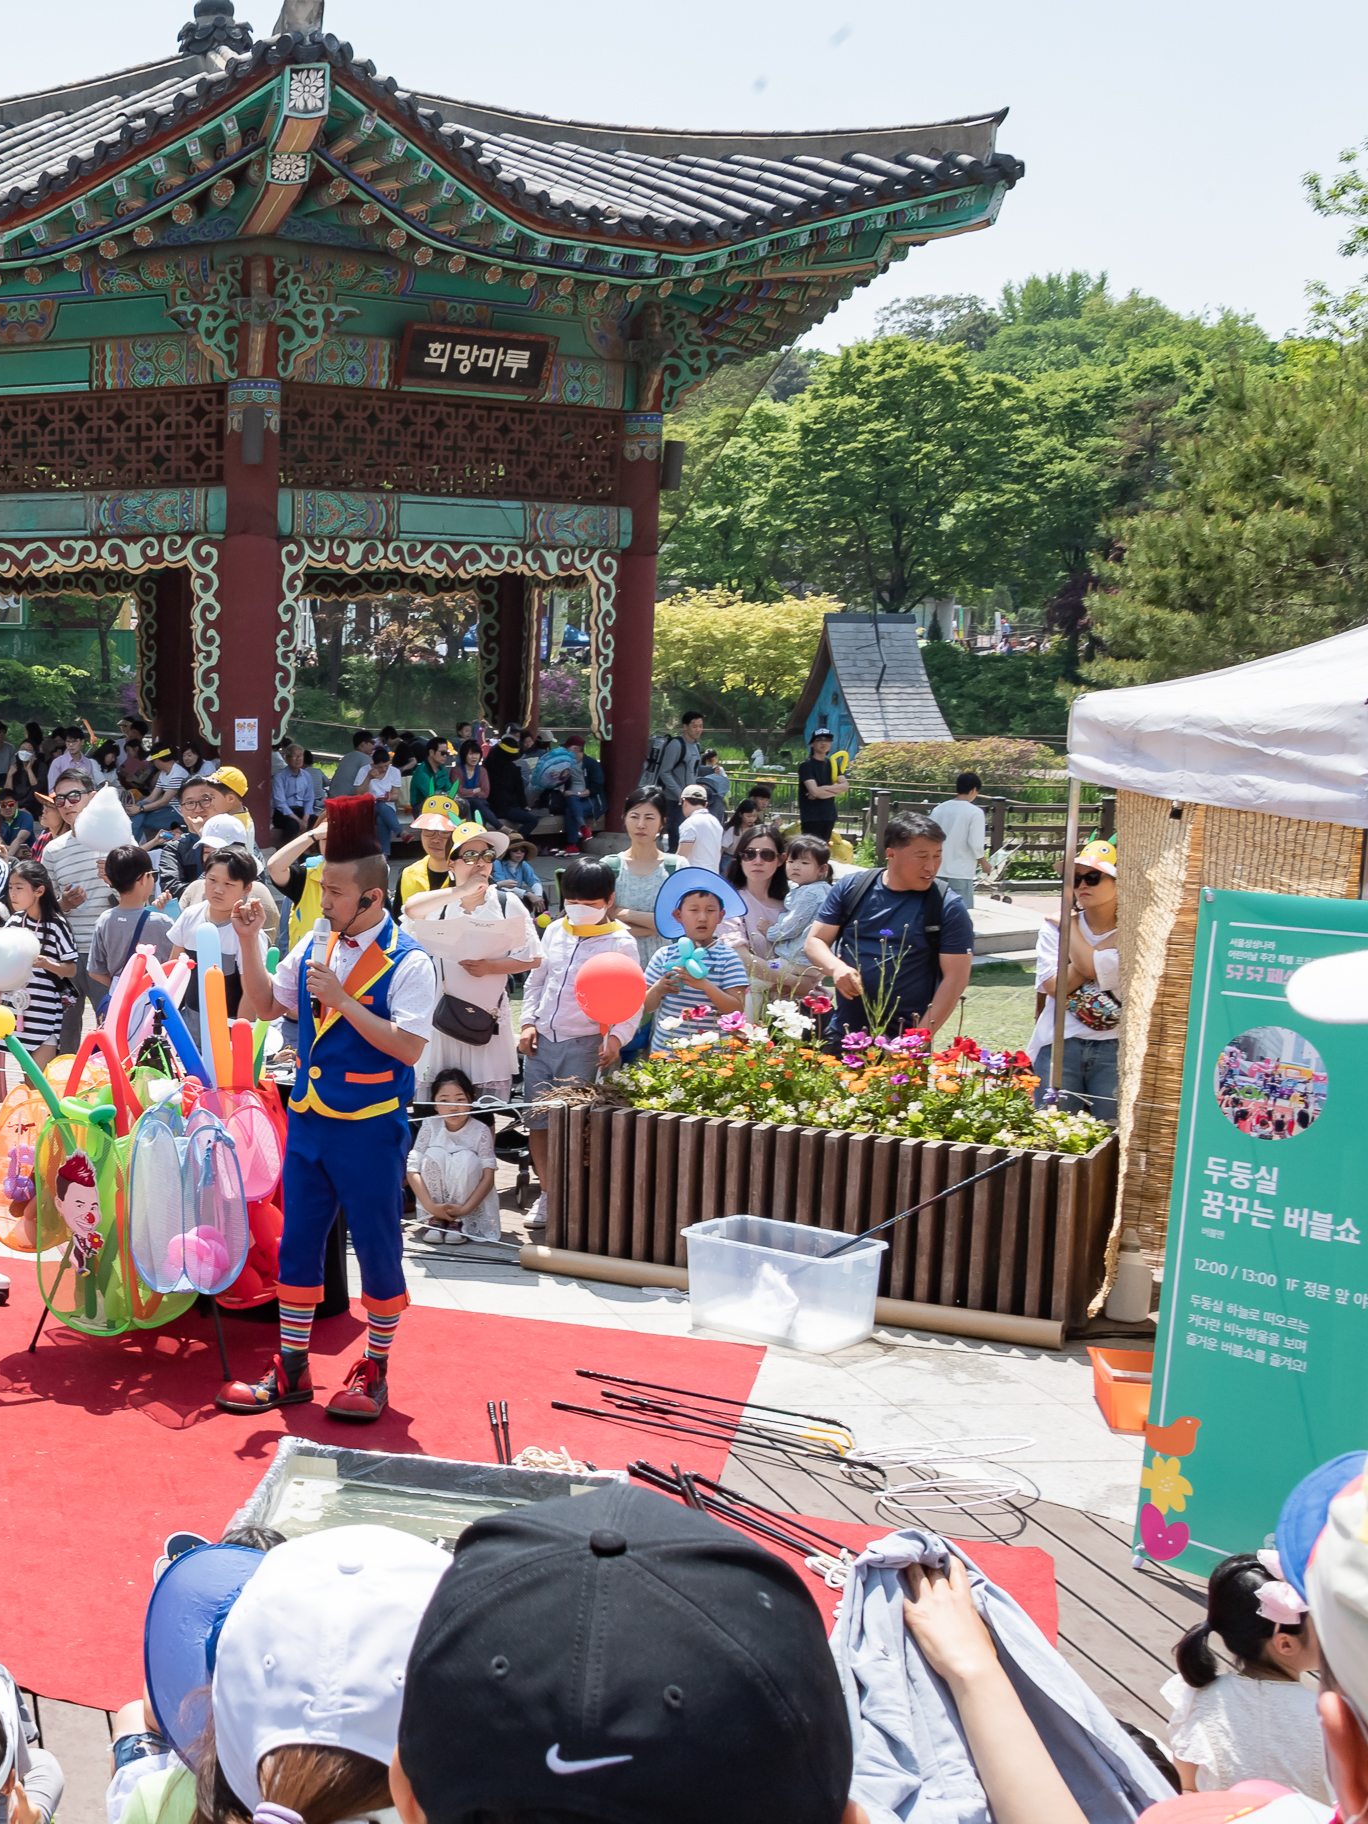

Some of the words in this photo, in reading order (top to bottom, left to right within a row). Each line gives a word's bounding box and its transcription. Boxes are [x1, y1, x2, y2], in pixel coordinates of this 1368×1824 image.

[424, 341, 531, 379] 희망마루
[1228, 950, 1258, 961] 어린이날
[1259, 953, 1276, 963] 주간
[1277, 954, 1294, 965] 특별
[1229, 938, 1276, 950] 서울상상나라
[1203, 1156, 1279, 1196] 두둥실
[1200, 1189, 1276, 1230] 꿈꾸는
[1283, 1206, 1361, 1245] 버블쇼
[1194, 1258, 1228, 1276] 12:00
[1242, 1268, 1277, 1287] 13:00
[1285, 1278, 1300, 1291] 1F
[1303, 1281, 1331, 1301] 정문
[1335, 1288, 1350, 1305] 앞
[1187, 1313, 1221, 1332] 커다란
[1223, 1322, 1280, 1347] 비누방울을
[1282, 1336, 1307, 1354] 보며
[1189, 1294, 1223, 1314] 두둥실
[1226, 1303, 1260, 1321] 하늘로
[1263, 1311, 1310, 1334] 떠오르는
[1186, 1332, 1218, 1351] 즐거운
[1220, 1341, 1266, 1364] 버블쇼를
[1269, 1353, 1307, 1373] 즐겨요!
